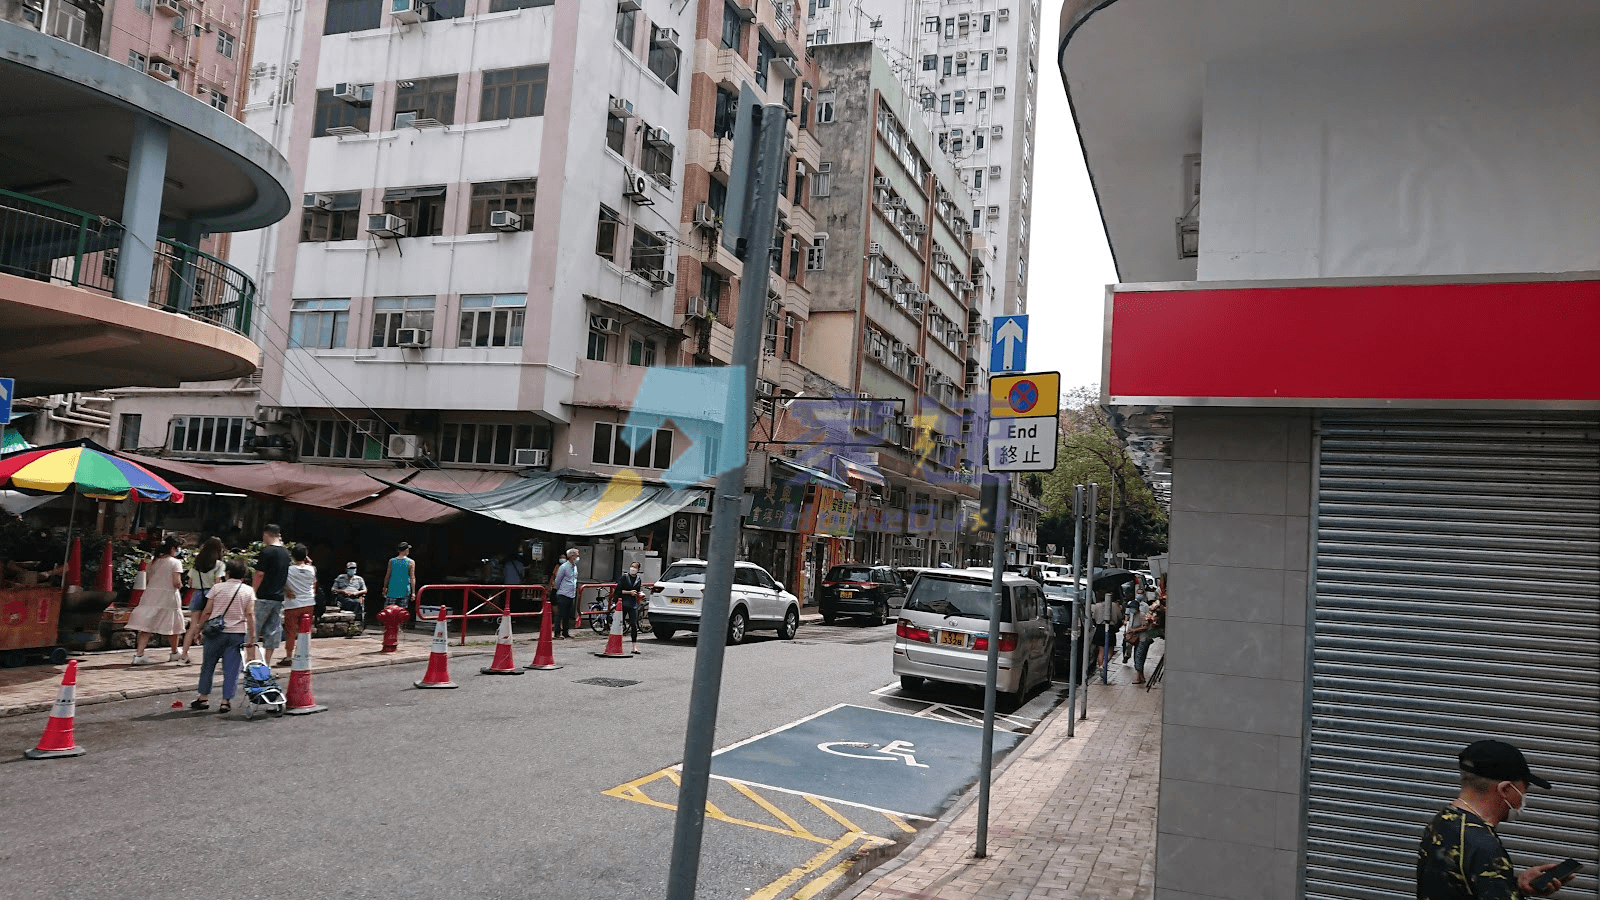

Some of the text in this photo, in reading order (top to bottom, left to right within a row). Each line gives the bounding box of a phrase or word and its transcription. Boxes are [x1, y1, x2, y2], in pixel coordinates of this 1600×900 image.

[1008, 424, 1037, 438] End
[999, 445, 1041, 464] 終止
[943, 637, 962, 645] 3328
